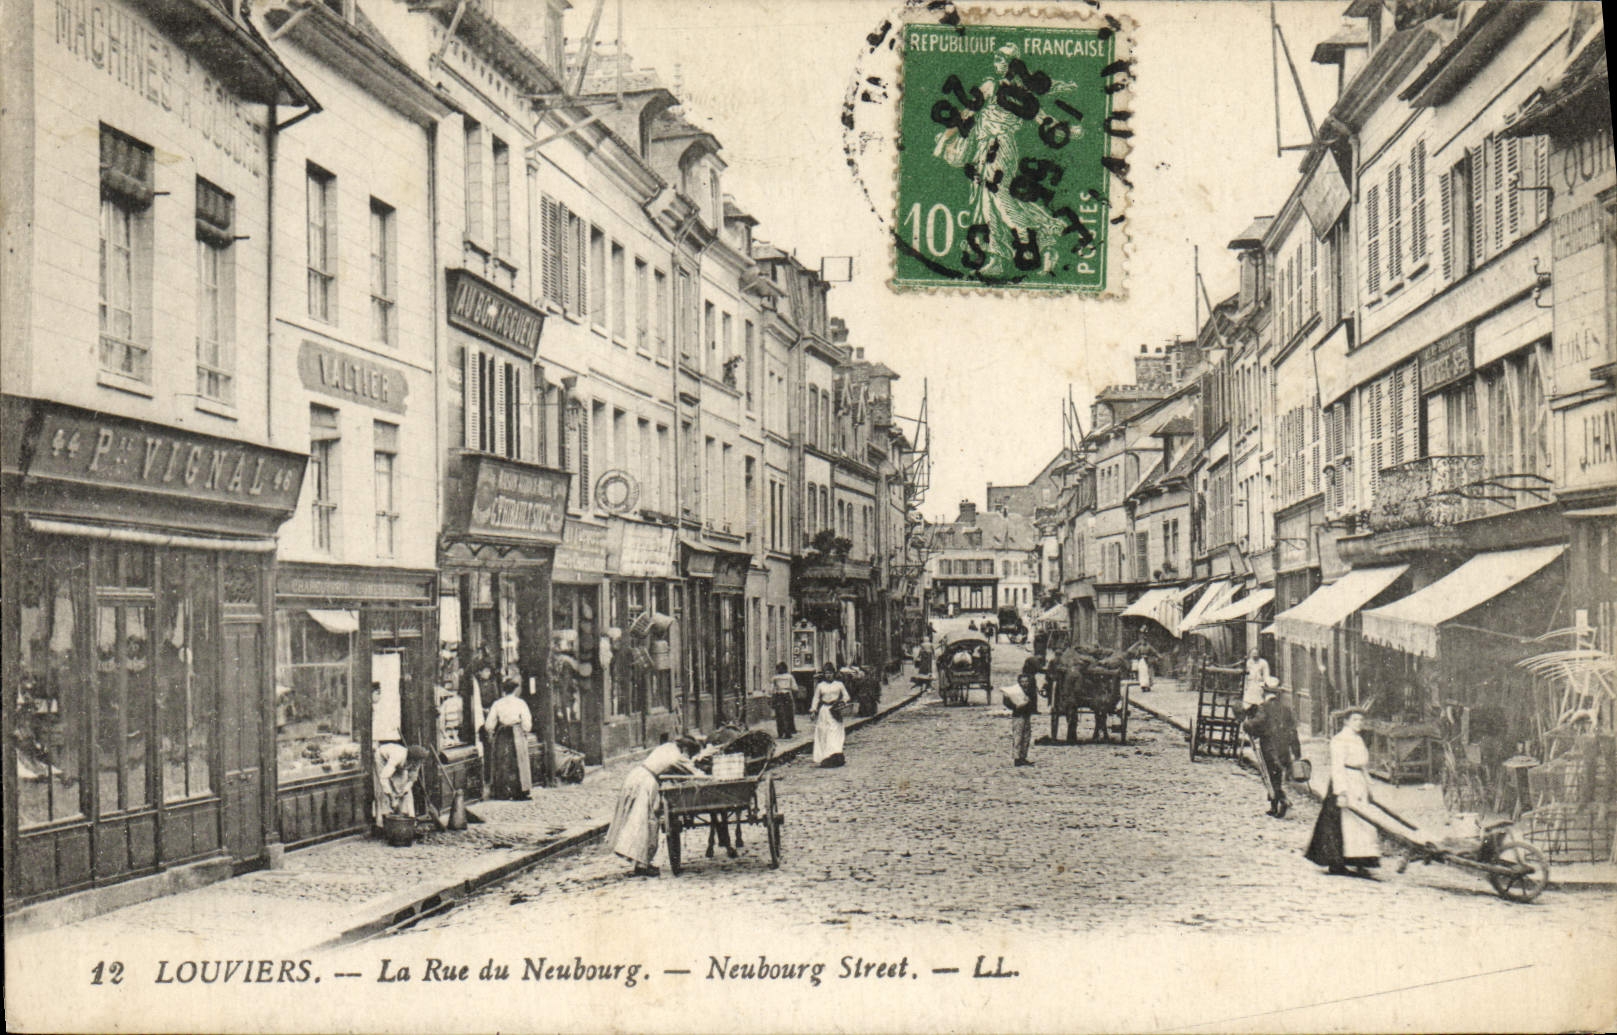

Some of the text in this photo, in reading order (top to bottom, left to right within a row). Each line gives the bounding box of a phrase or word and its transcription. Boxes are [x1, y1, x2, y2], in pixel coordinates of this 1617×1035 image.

[1023, 36, 1105, 58] FRANÇAISE
[903, 202, 955, 257] 10
[496, 305, 539, 350] ACCUEIL
[143, 437, 266, 496] VIGNAL
